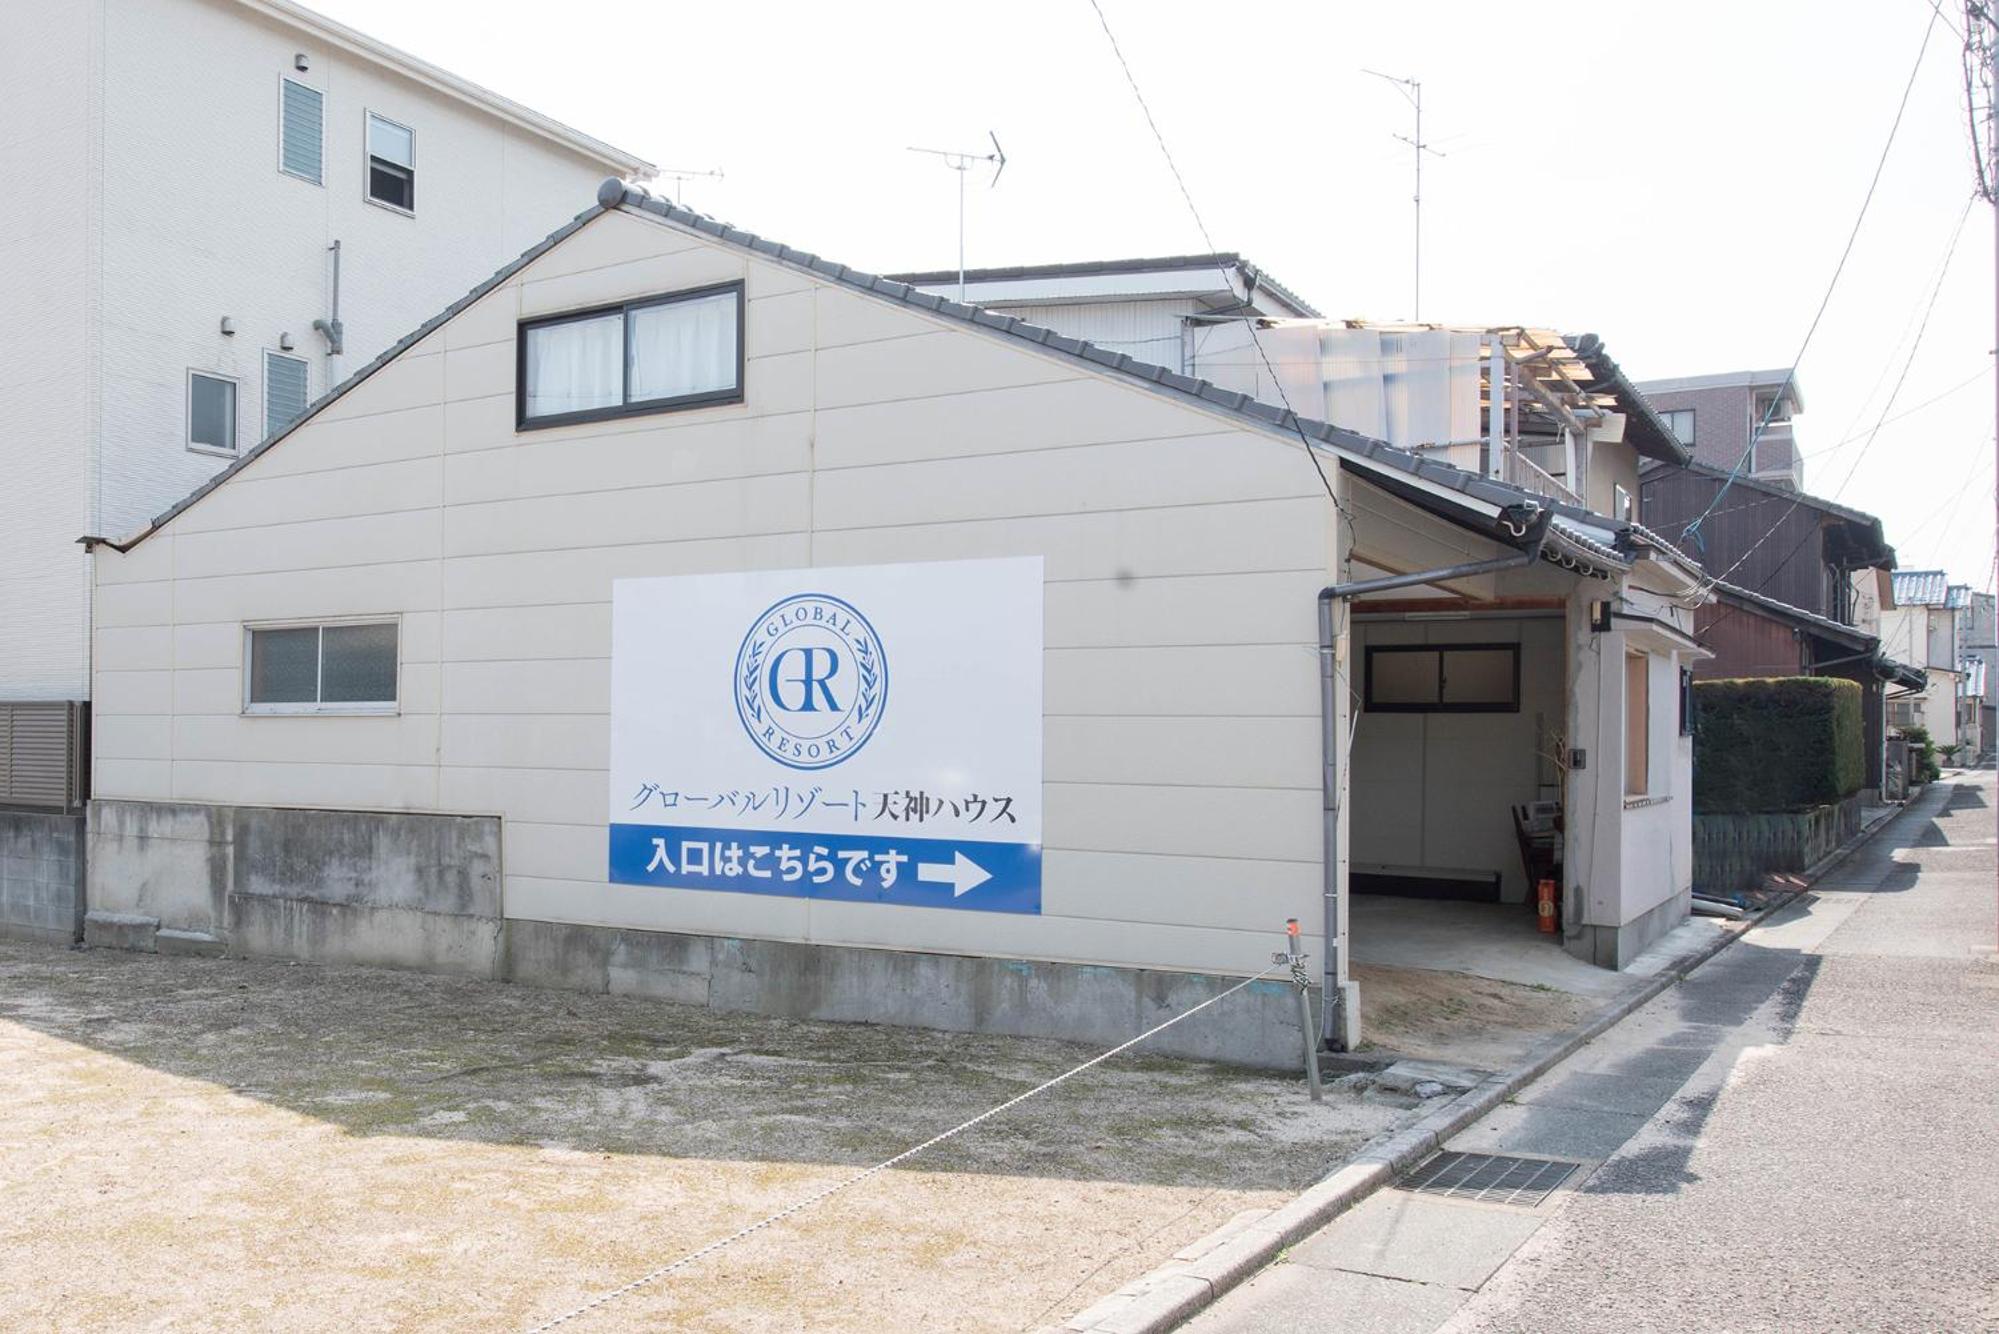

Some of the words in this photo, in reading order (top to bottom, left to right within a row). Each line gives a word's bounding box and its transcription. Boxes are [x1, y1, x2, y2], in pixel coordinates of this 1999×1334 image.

[766, 606, 852, 637] GLOBAL
[768, 647, 844, 713] GR
[763, 725, 854, 758] RESORT
[646, 838, 908, 888] 入口はこちらです
